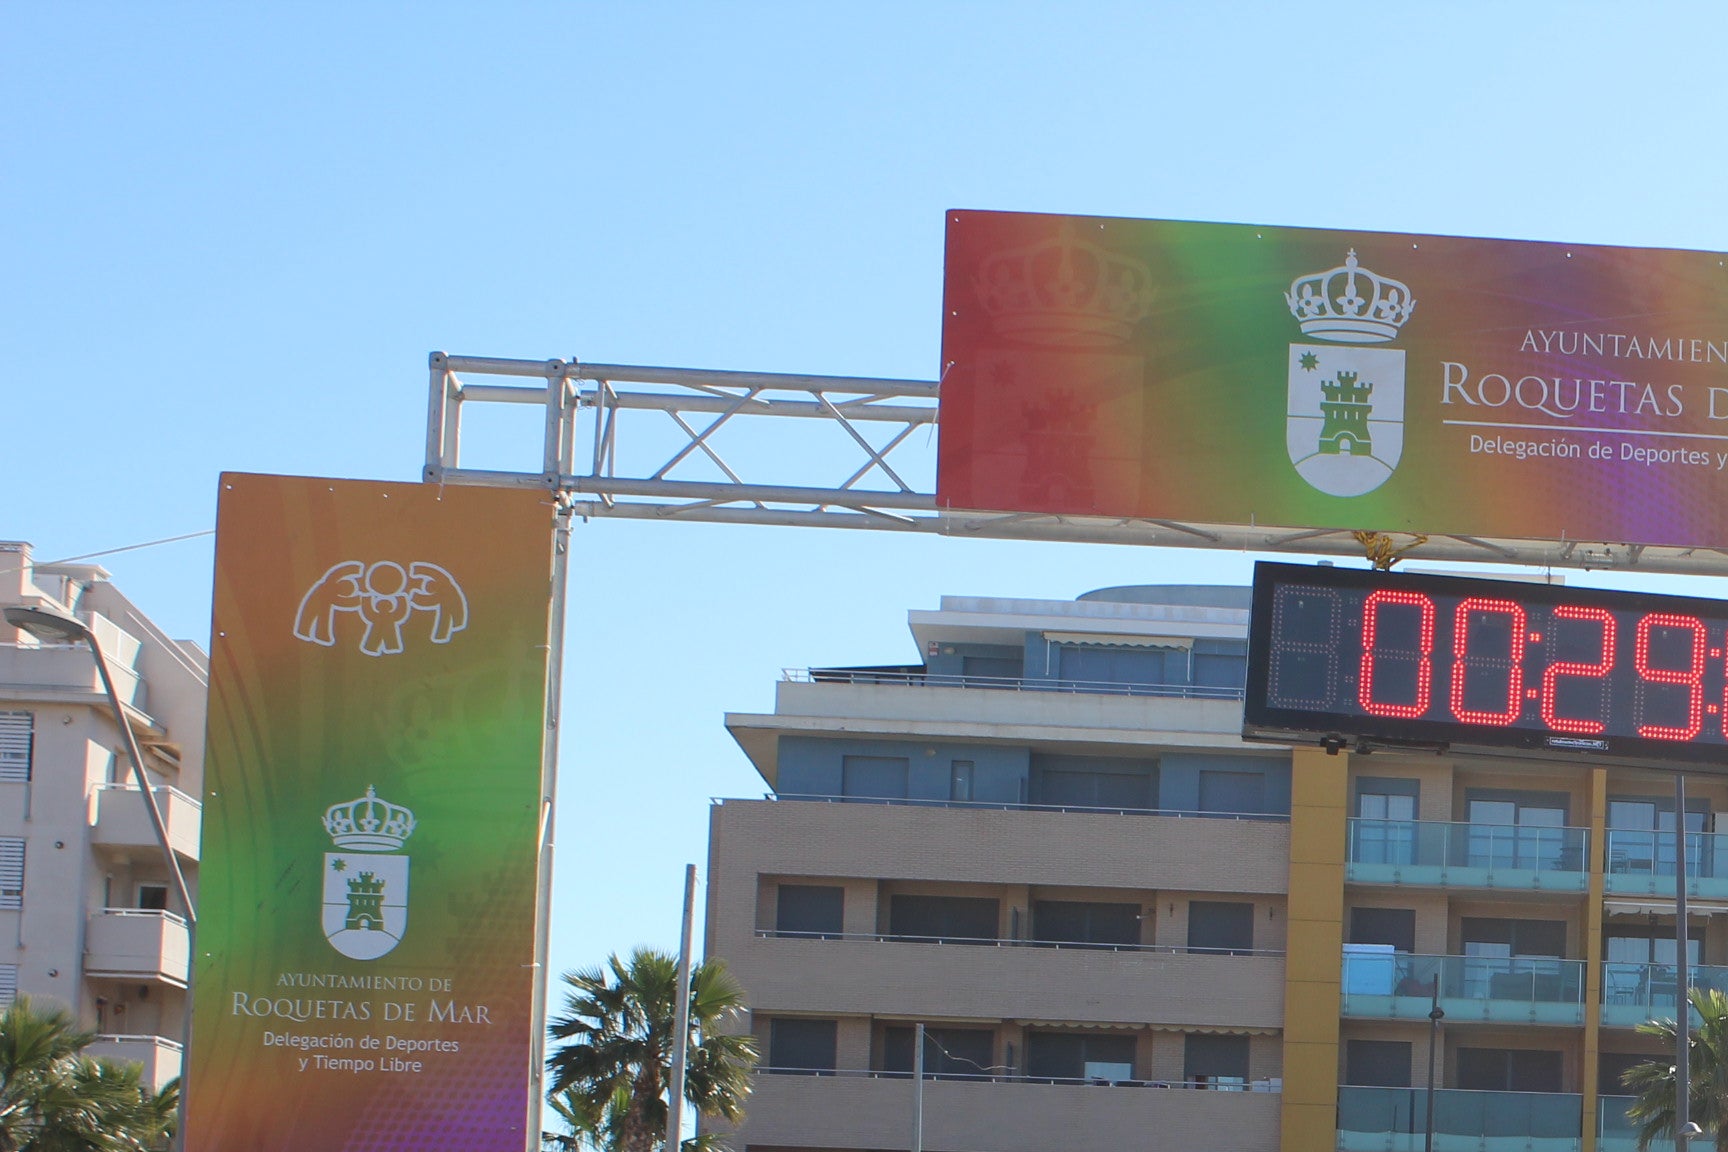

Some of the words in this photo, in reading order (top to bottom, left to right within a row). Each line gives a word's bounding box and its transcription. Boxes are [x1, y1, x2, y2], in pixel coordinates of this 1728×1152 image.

[1470, 434, 1580, 462] Delegación
[1588, 441, 1613, 461] de
[1620, 442, 1710, 467] Deportes
[1717, 452, 1728, 470] y
[276, 972, 423, 992] AYUNTAMIENTO
[429, 977, 452, 992] DE
[384, 1001, 415, 1022] DE
[263, 1031, 354, 1053] Delegación
[360, 1034, 380, 1050] de
[386, 1035, 459, 1054] Deportes
[299, 1058, 308, 1072] y
[313, 1054, 375, 1074] Tiempo
[380, 1056, 422, 1073] Libre
